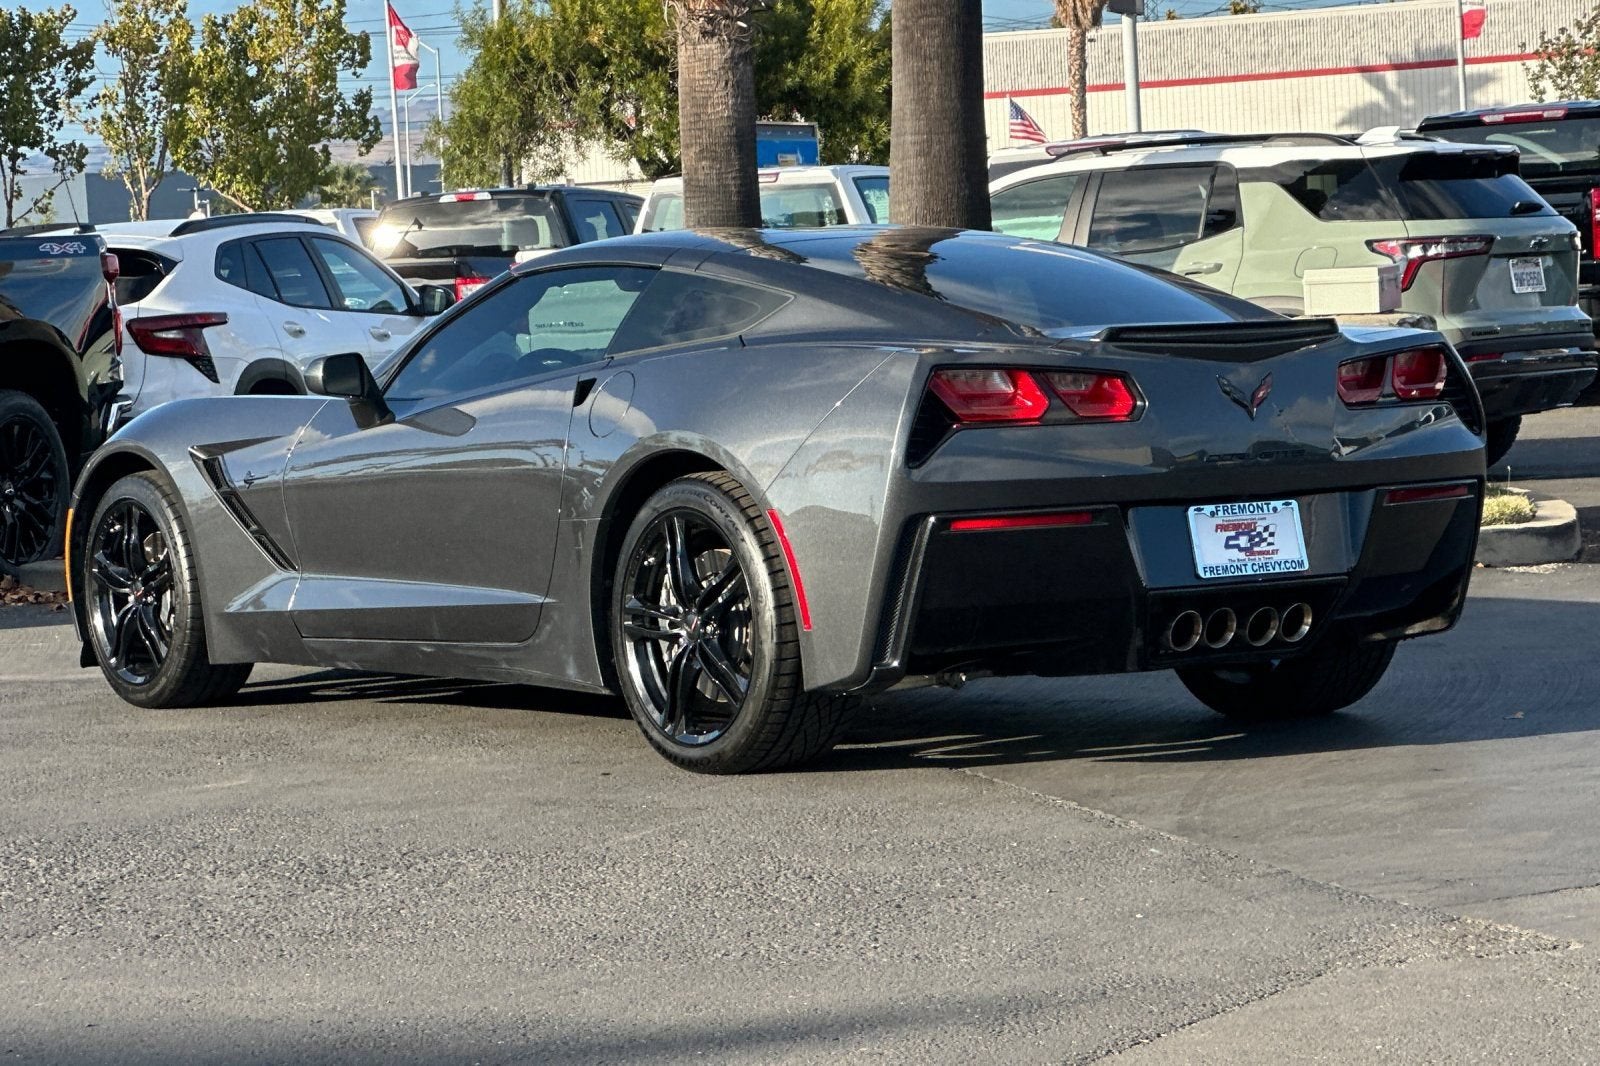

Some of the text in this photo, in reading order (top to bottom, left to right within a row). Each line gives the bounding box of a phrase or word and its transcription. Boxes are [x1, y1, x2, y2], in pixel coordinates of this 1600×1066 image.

[1215, 502, 1272, 516] FREMONT
[1215, 521, 1258, 533] FREMONT
[1203, 560, 1305, 577] FREMONT CHEVY.COM
